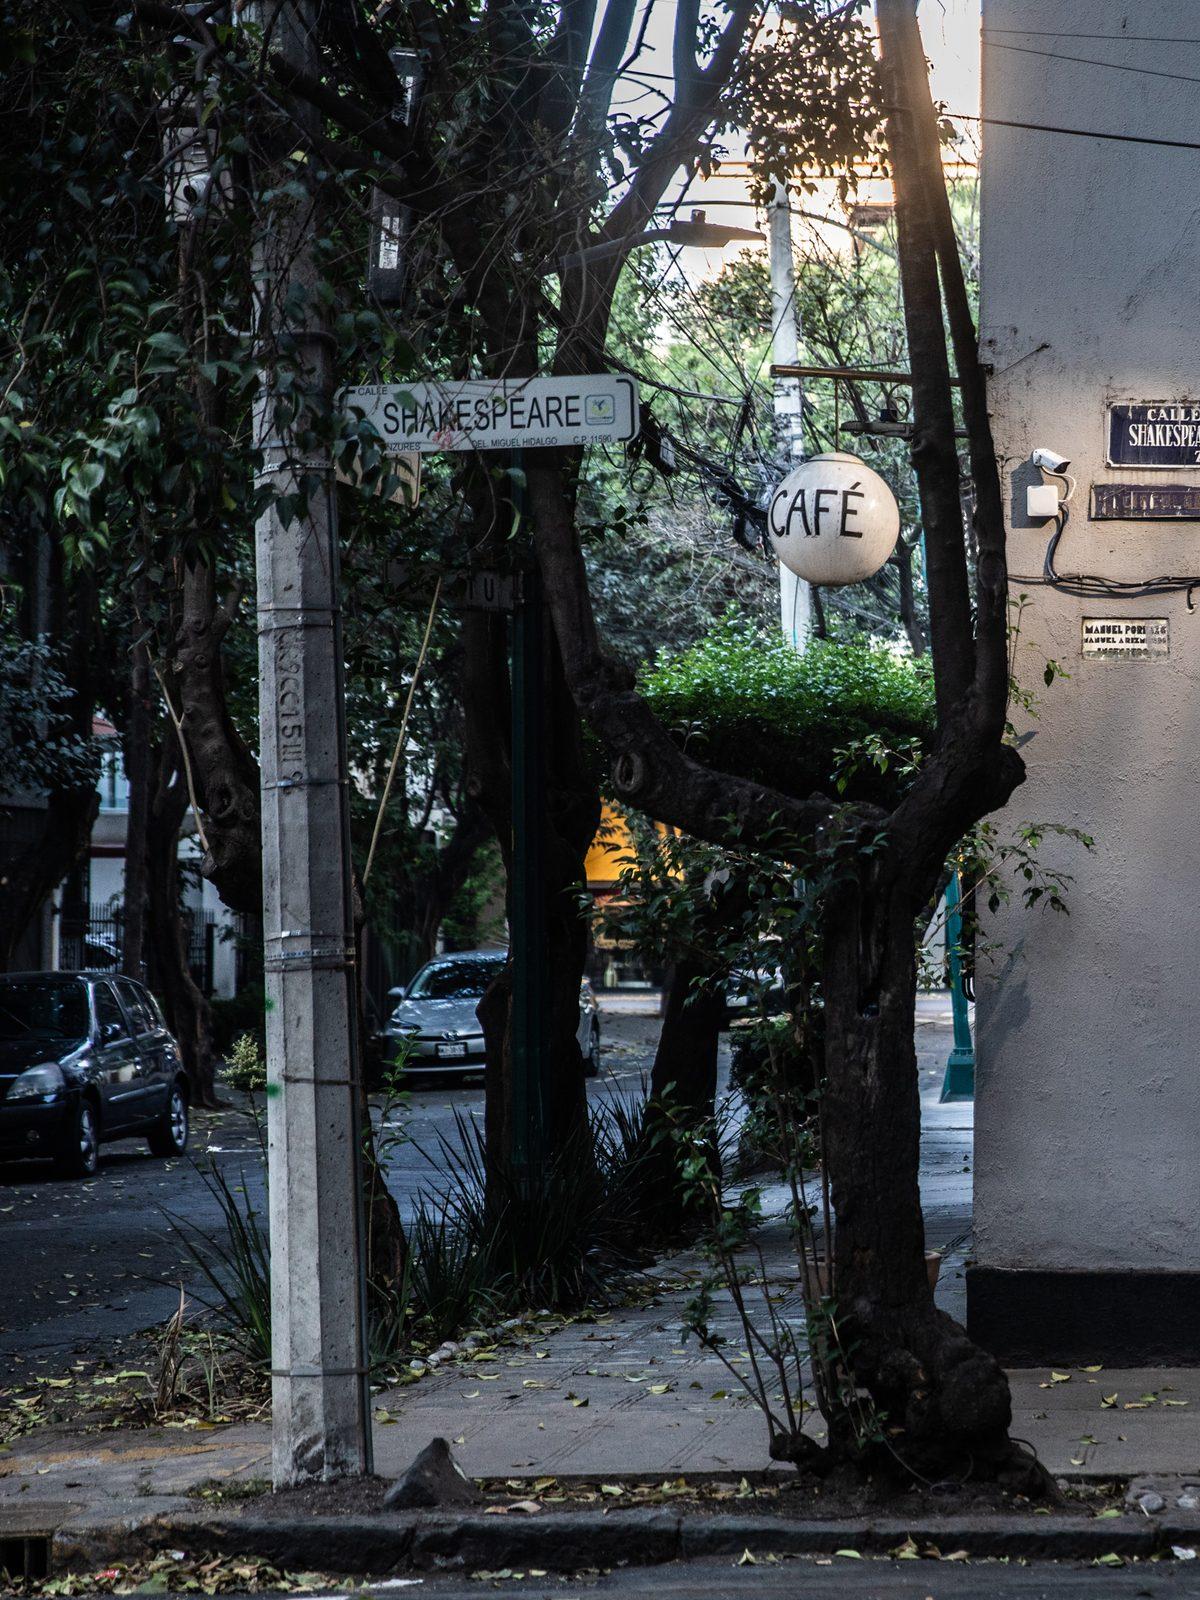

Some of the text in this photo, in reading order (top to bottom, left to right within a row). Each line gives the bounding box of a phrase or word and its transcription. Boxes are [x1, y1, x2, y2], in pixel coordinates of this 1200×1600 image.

[358, 386, 388, 396] CALLE
[383, 395, 581, 434] SHAKESPEARE
[1147, 408, 1200, 421] CALLE
[386, 441, 422, 451] NZURES
[491, 439, 521, 448] MIGUEL
[523, 436, 558, 446] HIDALGO
[770, 481, 865, 538] CAFÉ
[1085, 625, 1123, 634] MANUEL
